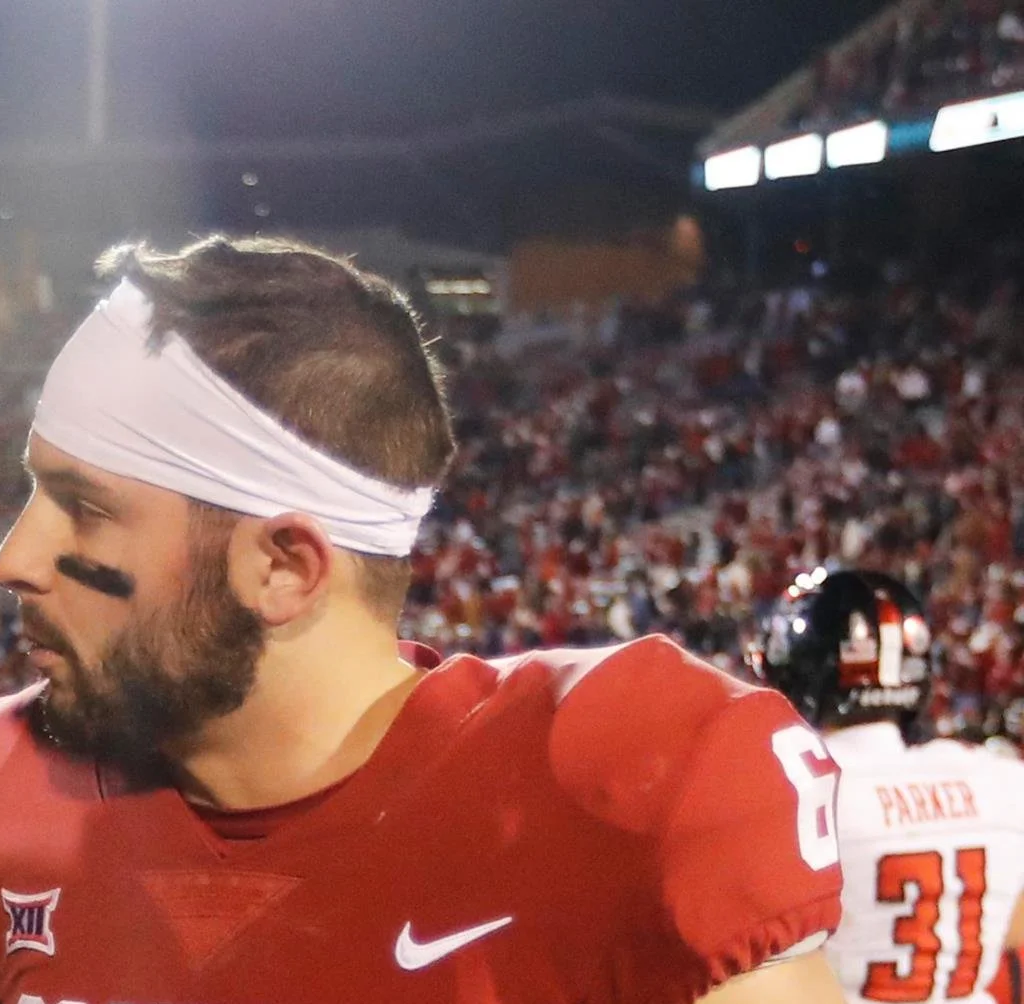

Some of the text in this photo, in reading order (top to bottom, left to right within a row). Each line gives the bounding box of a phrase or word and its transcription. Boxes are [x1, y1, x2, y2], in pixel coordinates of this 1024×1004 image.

[772, 724, 840, 872] 6
[876, 781, 979, 829] PARKER
[859, 847, 987, 1004] 31
